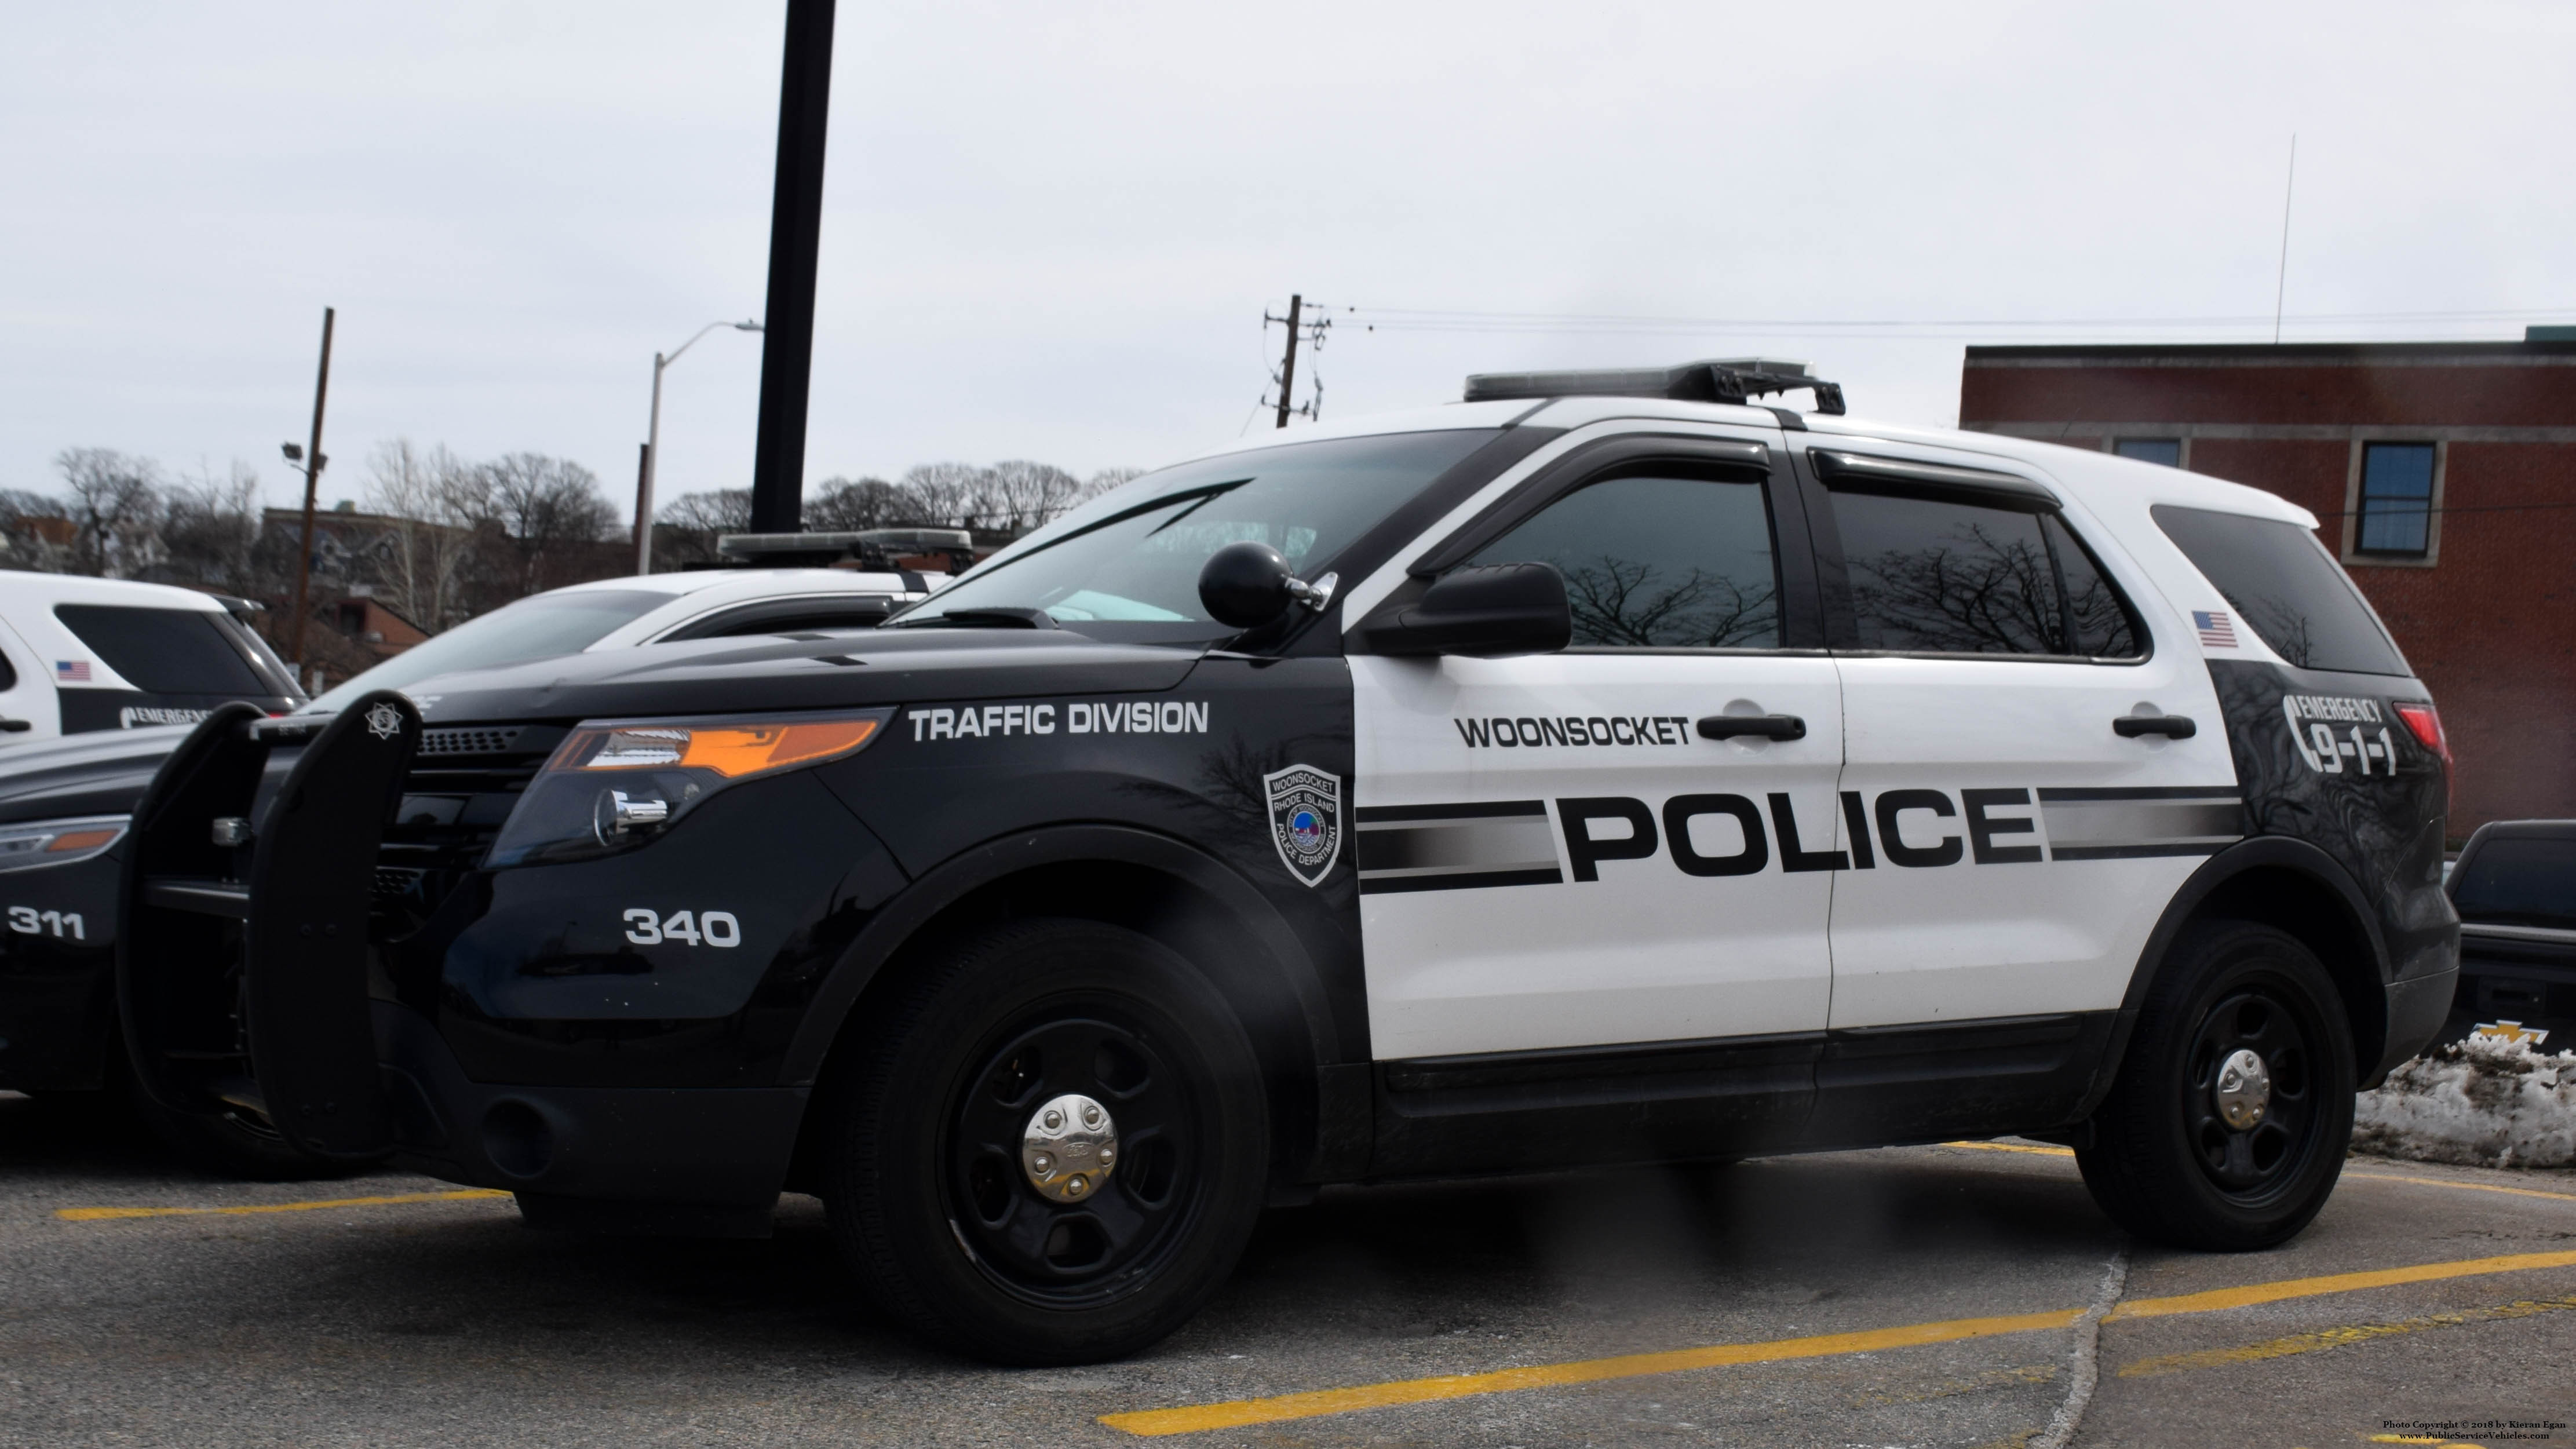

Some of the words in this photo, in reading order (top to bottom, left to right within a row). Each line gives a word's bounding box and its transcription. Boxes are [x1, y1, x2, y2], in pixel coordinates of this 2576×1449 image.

[908, 705, 1055, 742] TRAFFIC
[1068, 702, 1208, 733] DIVISION
[2296, 695, 2382, 722] EMERGENCY
[1454, 717, 1689, 748] WOONSOCKET
[2310, 724, 2396, 776] 9-1-1
[1273, 773, 1333, 792] WOONSOCKET
[1274, 793, 1301, 811] RHODE
[1304, 793, 1334, 812] ISLAND
[1277, 823, 1297, 859] POLICE
[1299, 825, 1336, 866] DEPARTMENT
[1555, 787, 2043, 882] POLICE
[8, 906, 85, 940] 311
[623, 908, 740, 947] 340
